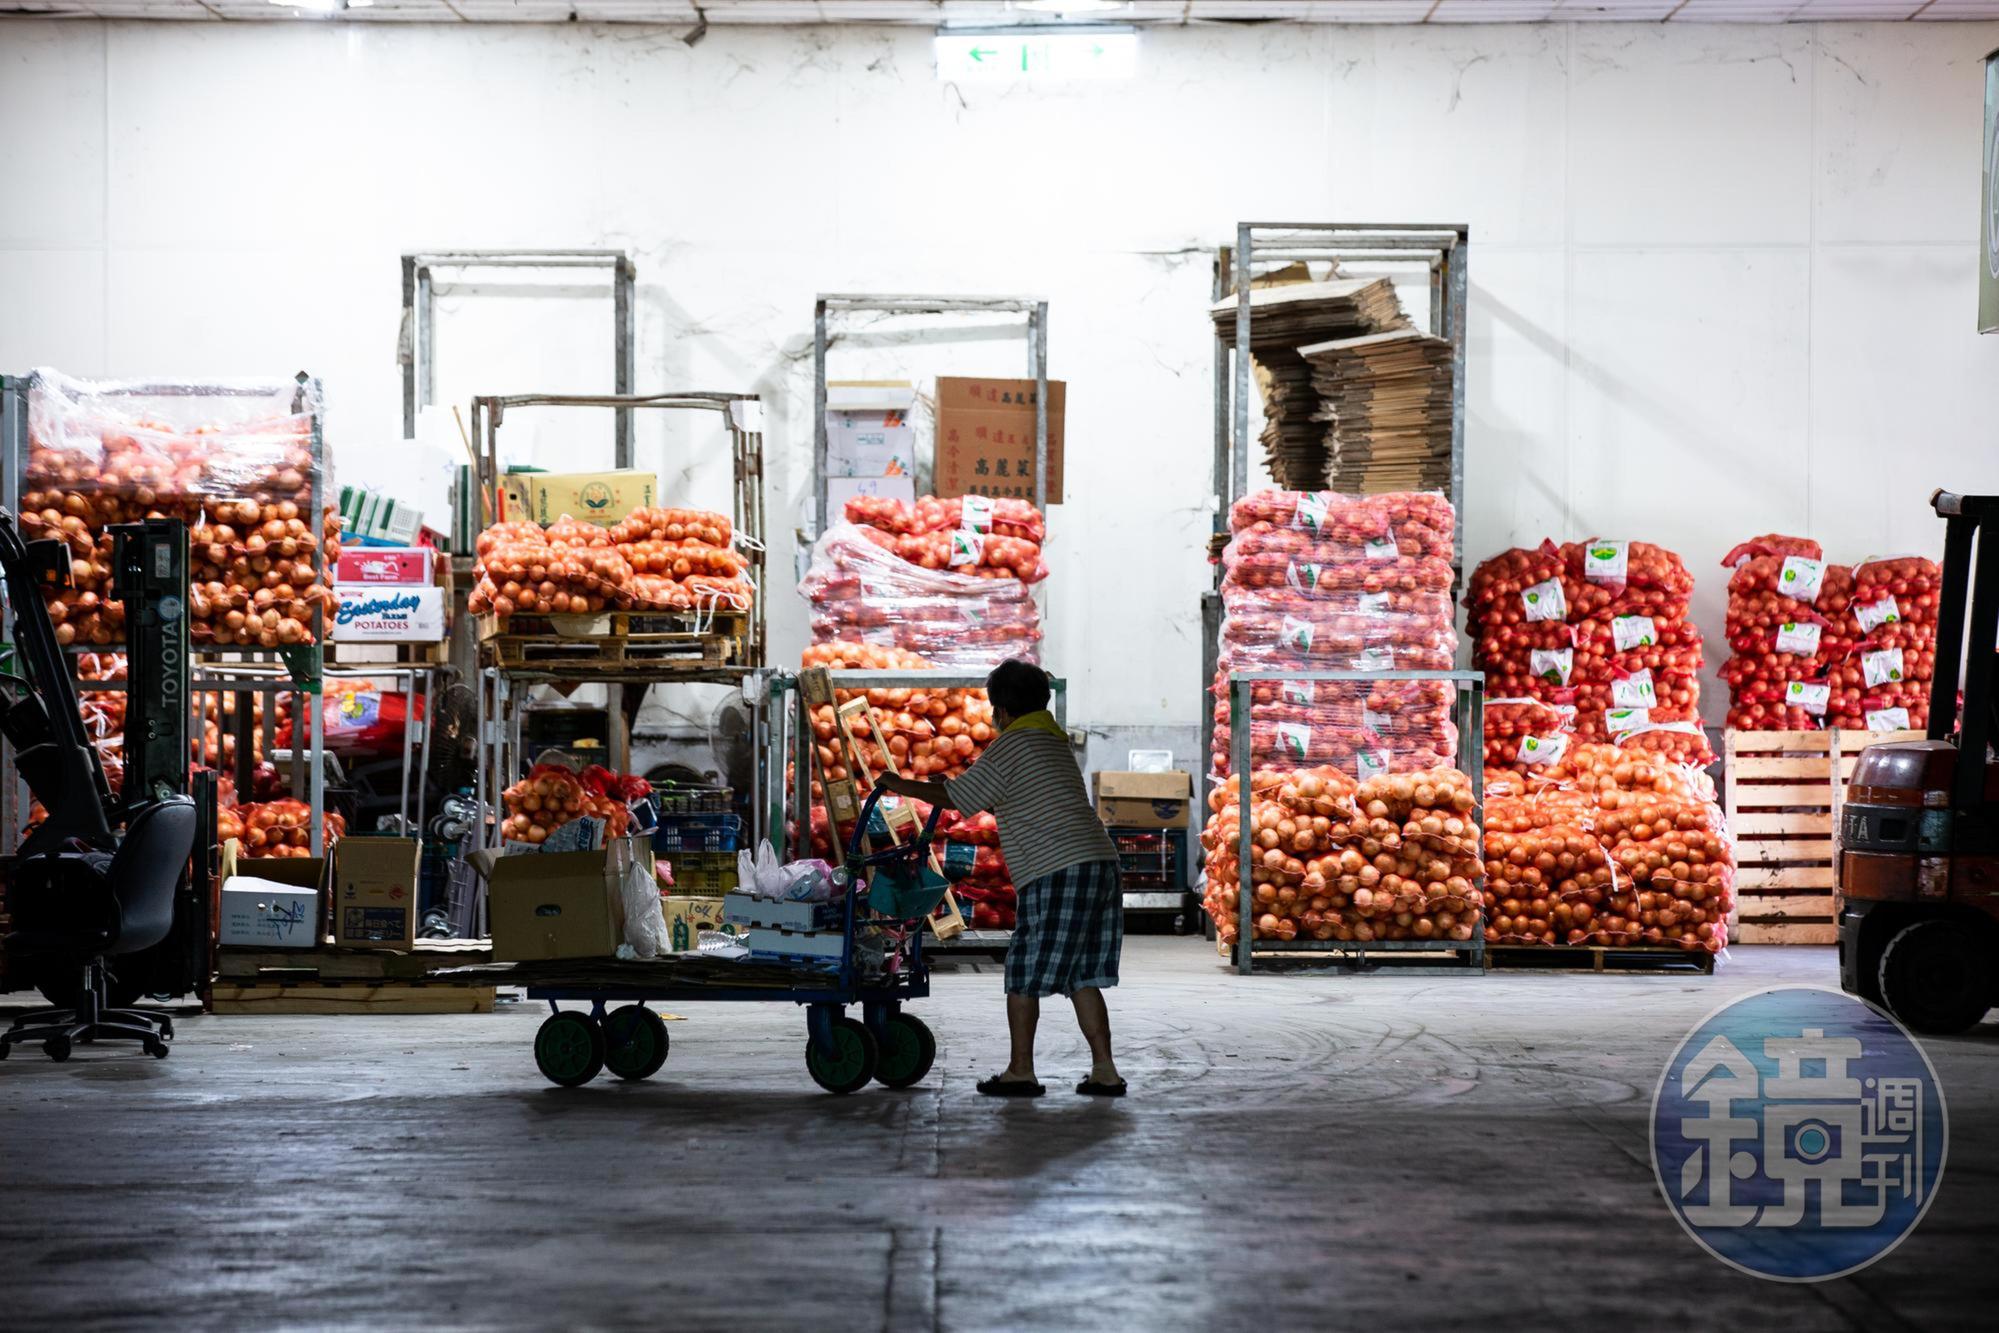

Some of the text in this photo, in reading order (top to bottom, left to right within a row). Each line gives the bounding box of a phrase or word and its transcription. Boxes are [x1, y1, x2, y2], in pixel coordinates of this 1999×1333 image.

[975, 457, 1030, 477] 高麗菜
[354, 621, 409, 630] POTATOES
[162, 621, 179, 708] TOYOTA
